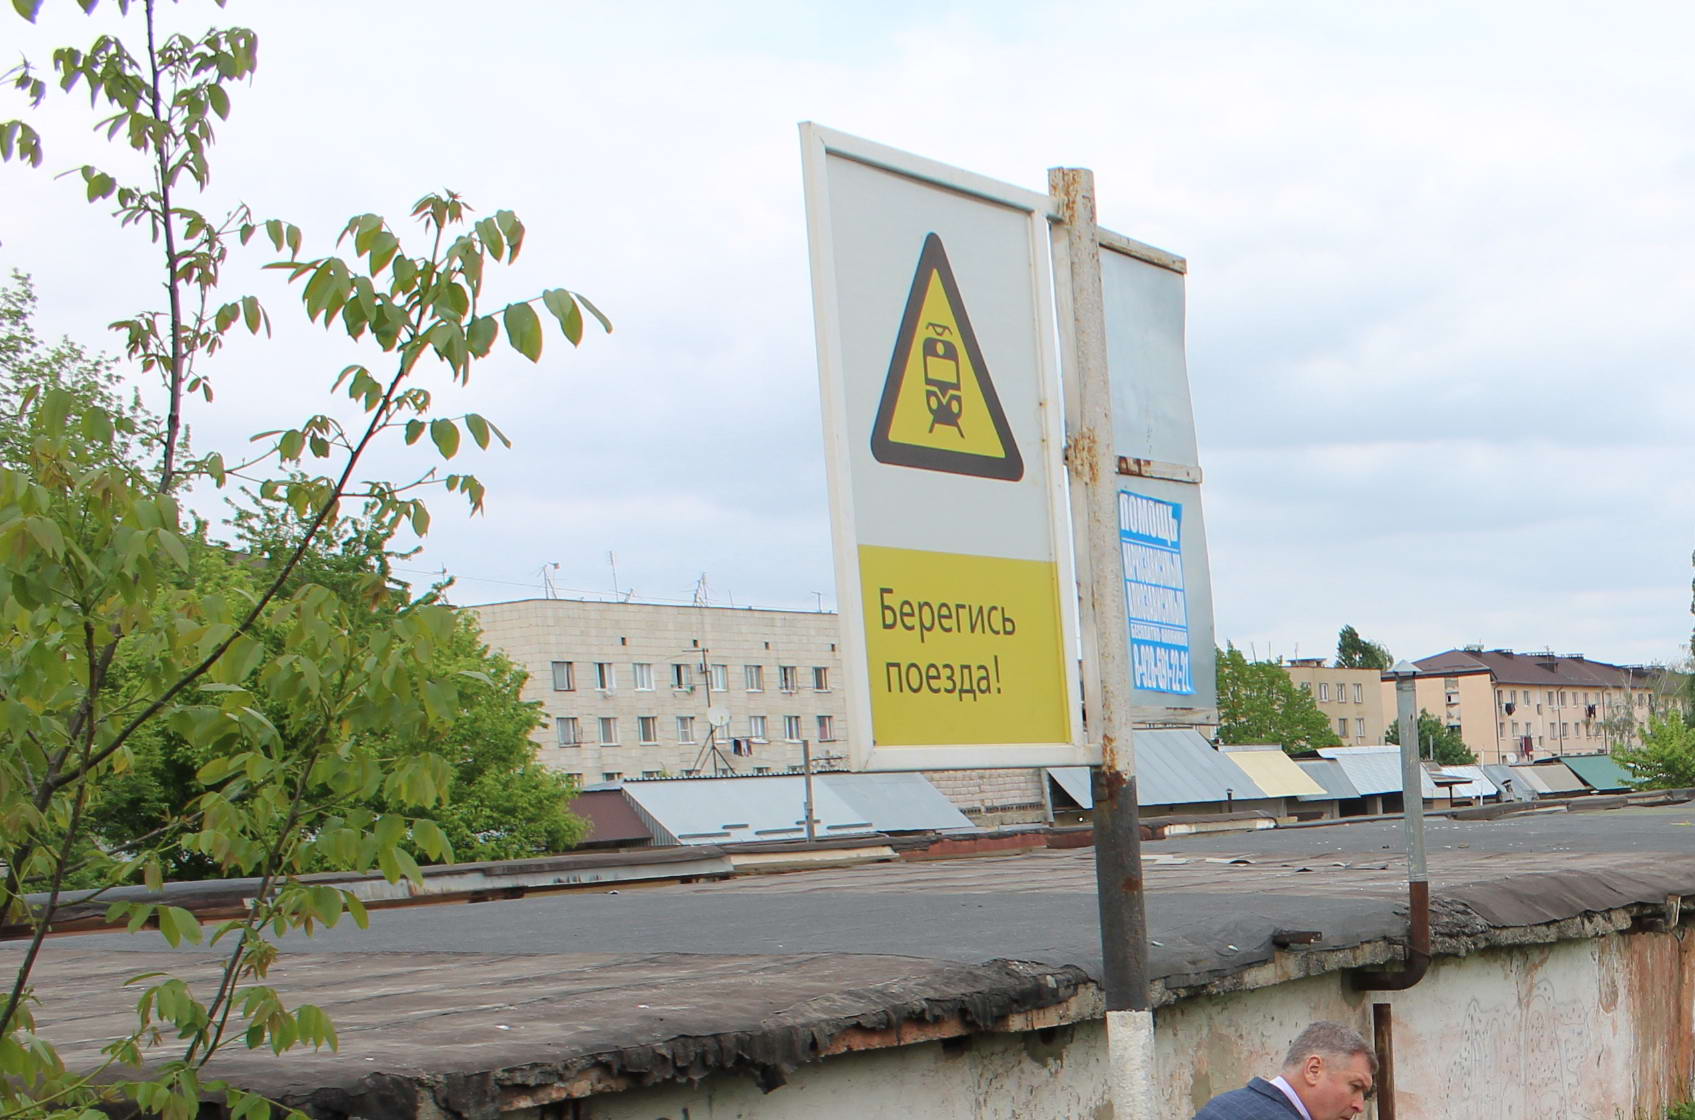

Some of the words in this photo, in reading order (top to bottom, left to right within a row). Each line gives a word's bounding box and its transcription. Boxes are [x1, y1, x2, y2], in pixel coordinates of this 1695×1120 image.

[1119, 493, 1179, 547] ПОМОЩЬ
[880, 587, 1016, 643] Берегись
[886, 655, 1001, 701] поезда!
